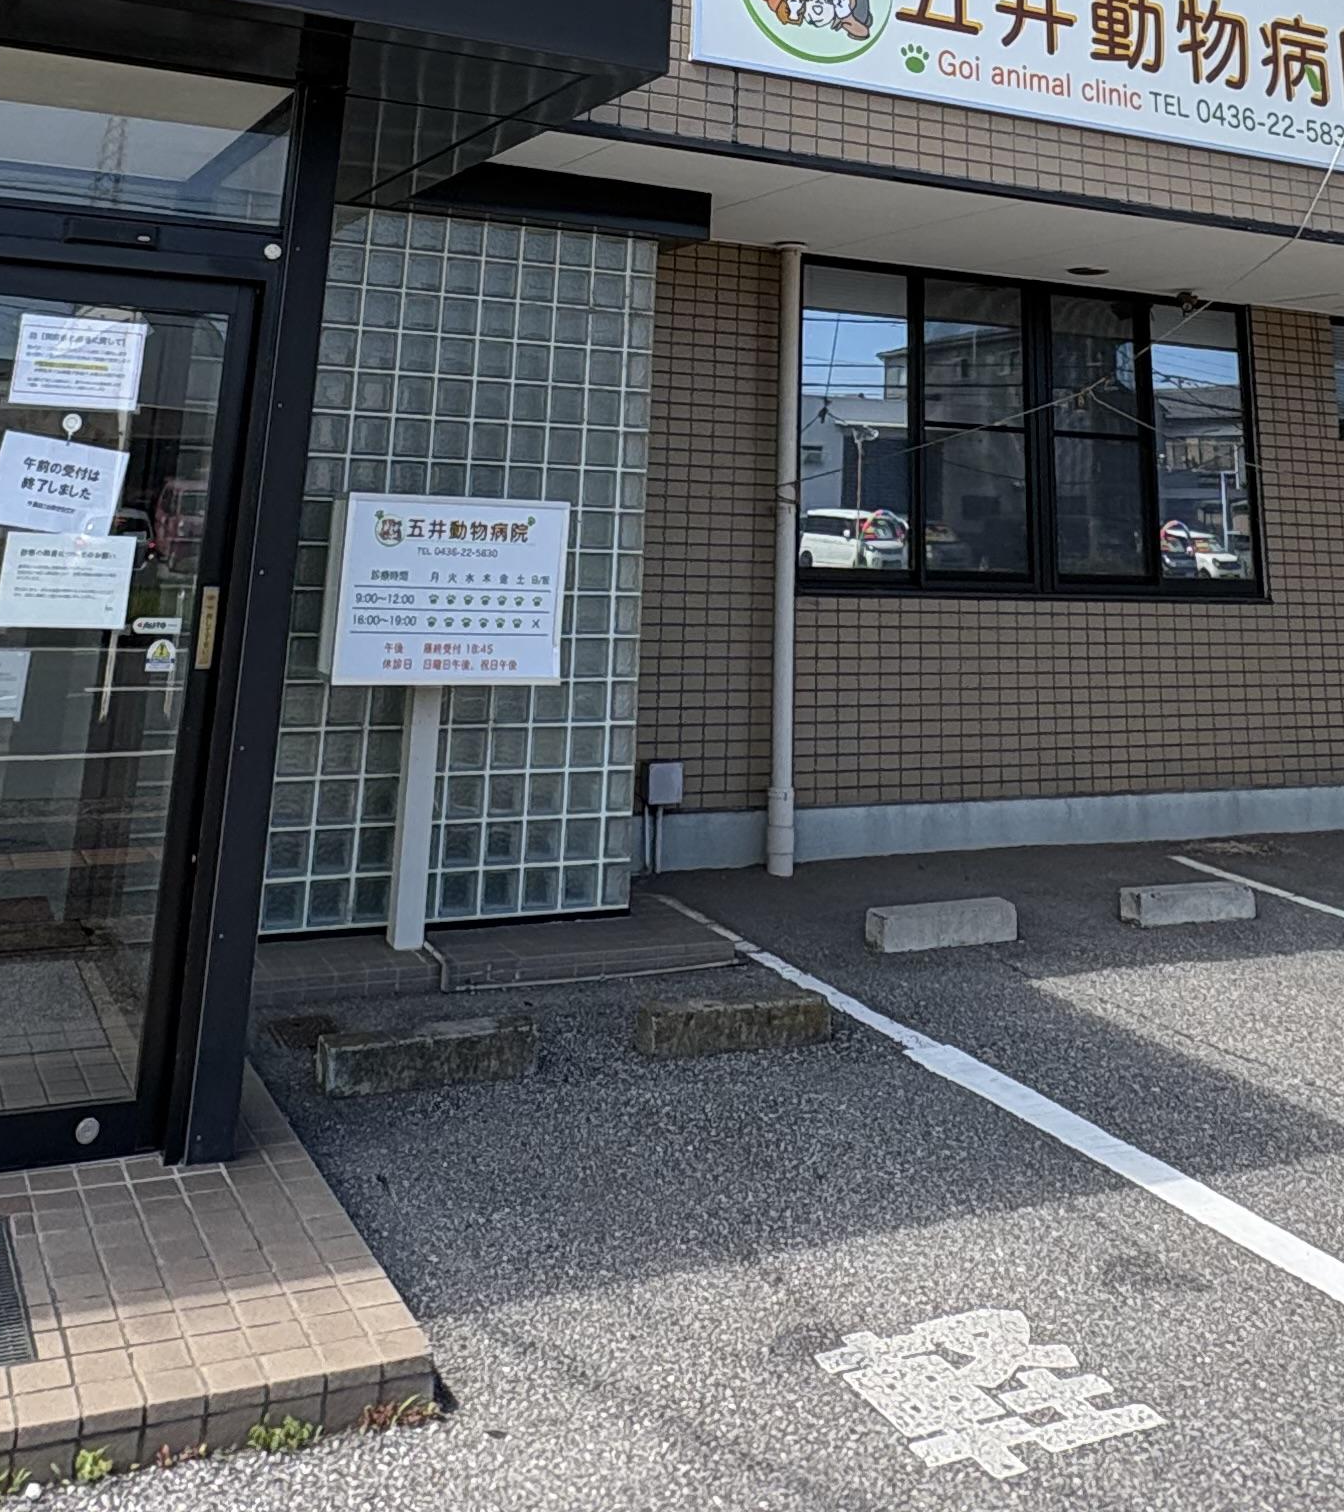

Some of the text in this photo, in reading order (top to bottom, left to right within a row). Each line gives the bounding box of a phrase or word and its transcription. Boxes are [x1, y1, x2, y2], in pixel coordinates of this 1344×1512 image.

[937, 49, 981, 82] Goi
[991, 61, 1072, 99] animal
[1081, 78, 1142, 111] clinic
[1149, 91, 1190, 120] TEL
[23, 456, 100, 482] 午前の受付は
[21, 476, 92, 500] 終了しました
[407, 518, 529, 544] 五井動物病院
[418, 547, 432, 556] TEL
[371, 569, 409, 581] 診療時間
[430, 571, 439, 582] 月
[448, 572, 457, 583] 火
[465, 573, 474, 584] 水
[482, 574, 491, 584] 木
[499, 574, 508, 584] 金
[517, 574, 525, 585] 土
[384, 642, 404, 654] 午後
[382, 659, 412, 670] 休診日
